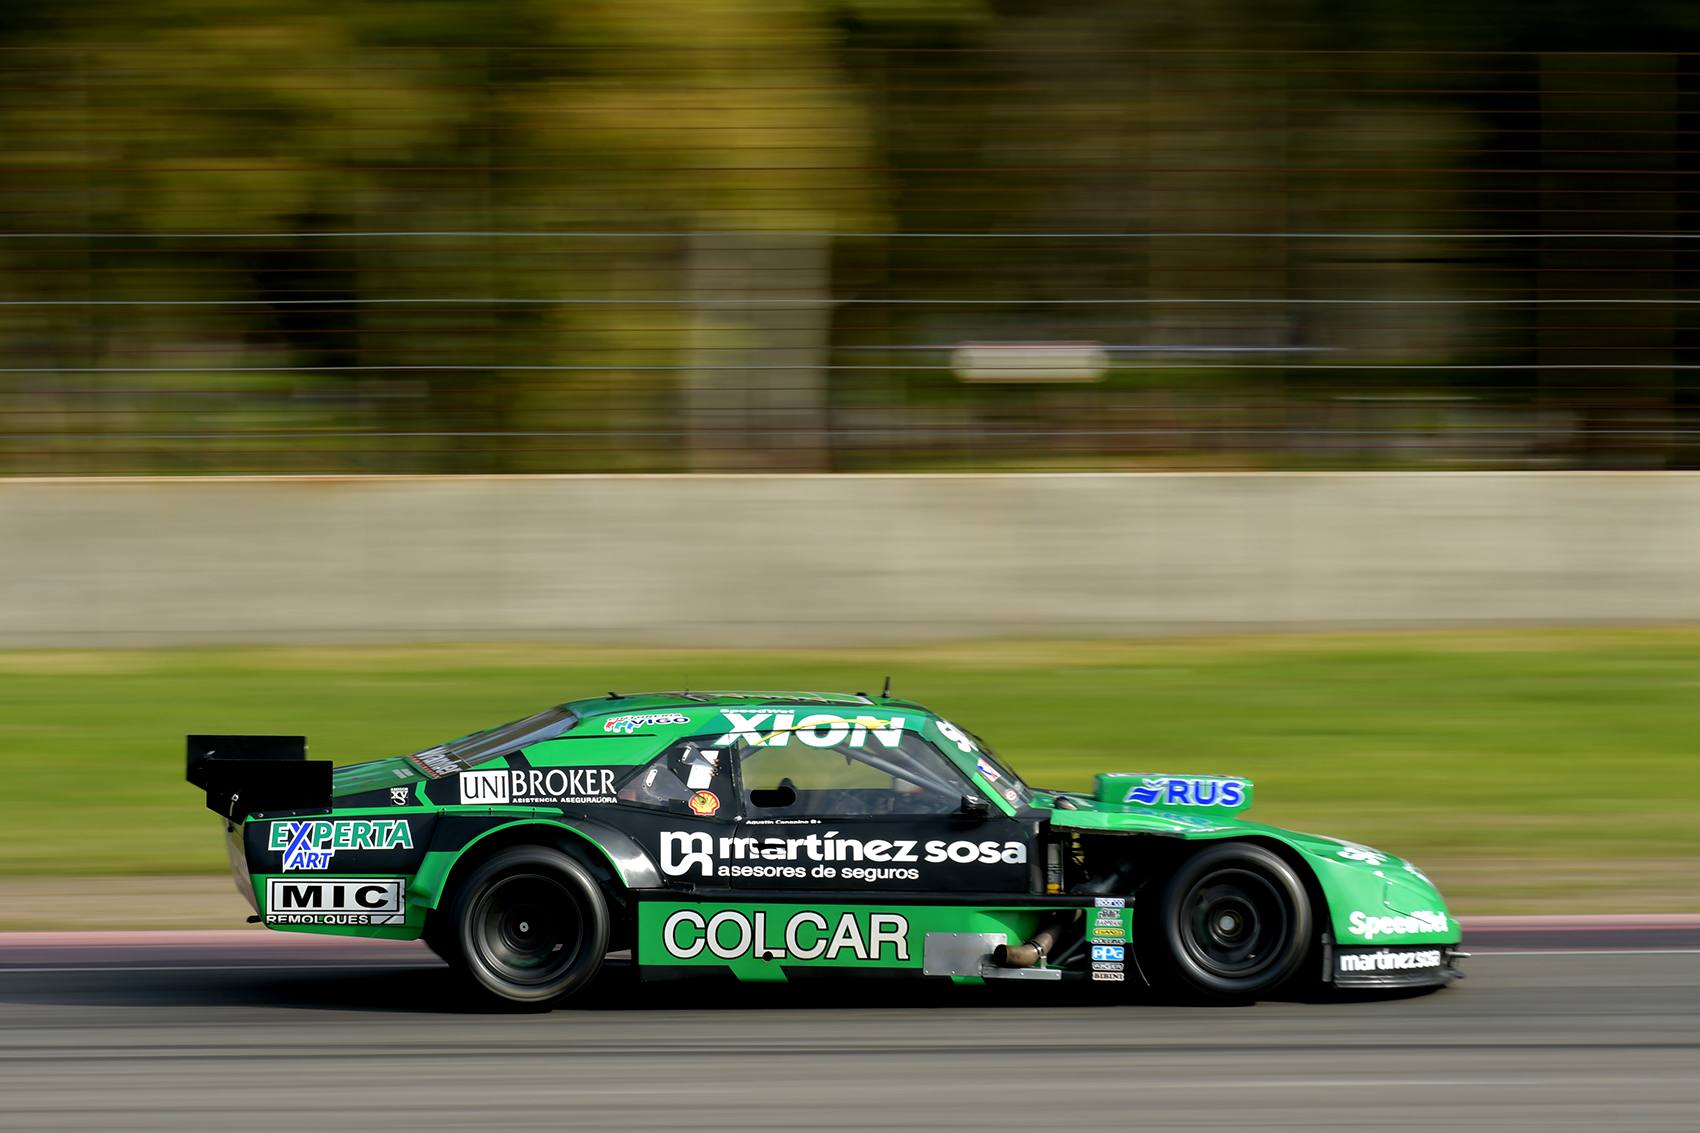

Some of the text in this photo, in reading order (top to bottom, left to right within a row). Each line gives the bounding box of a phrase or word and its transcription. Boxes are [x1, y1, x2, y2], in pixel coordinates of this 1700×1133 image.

[713, 713, 906, 748] XION
[1166, 779, 1242, 806] RUS
[268, 820, 414, 852] EXPERTA
[719, 831, 1028, 864] martínez sosa
[287, 851, 336, 869] ART
[717, 863, 920, 882] asesores de seguros
[282, 885, 389, 909] MIC
[266, 915, 369, 925] REMOLQUES
[662, 909, 911, 961] COLCAR
[1093, 946, 1124, 960] PPG
